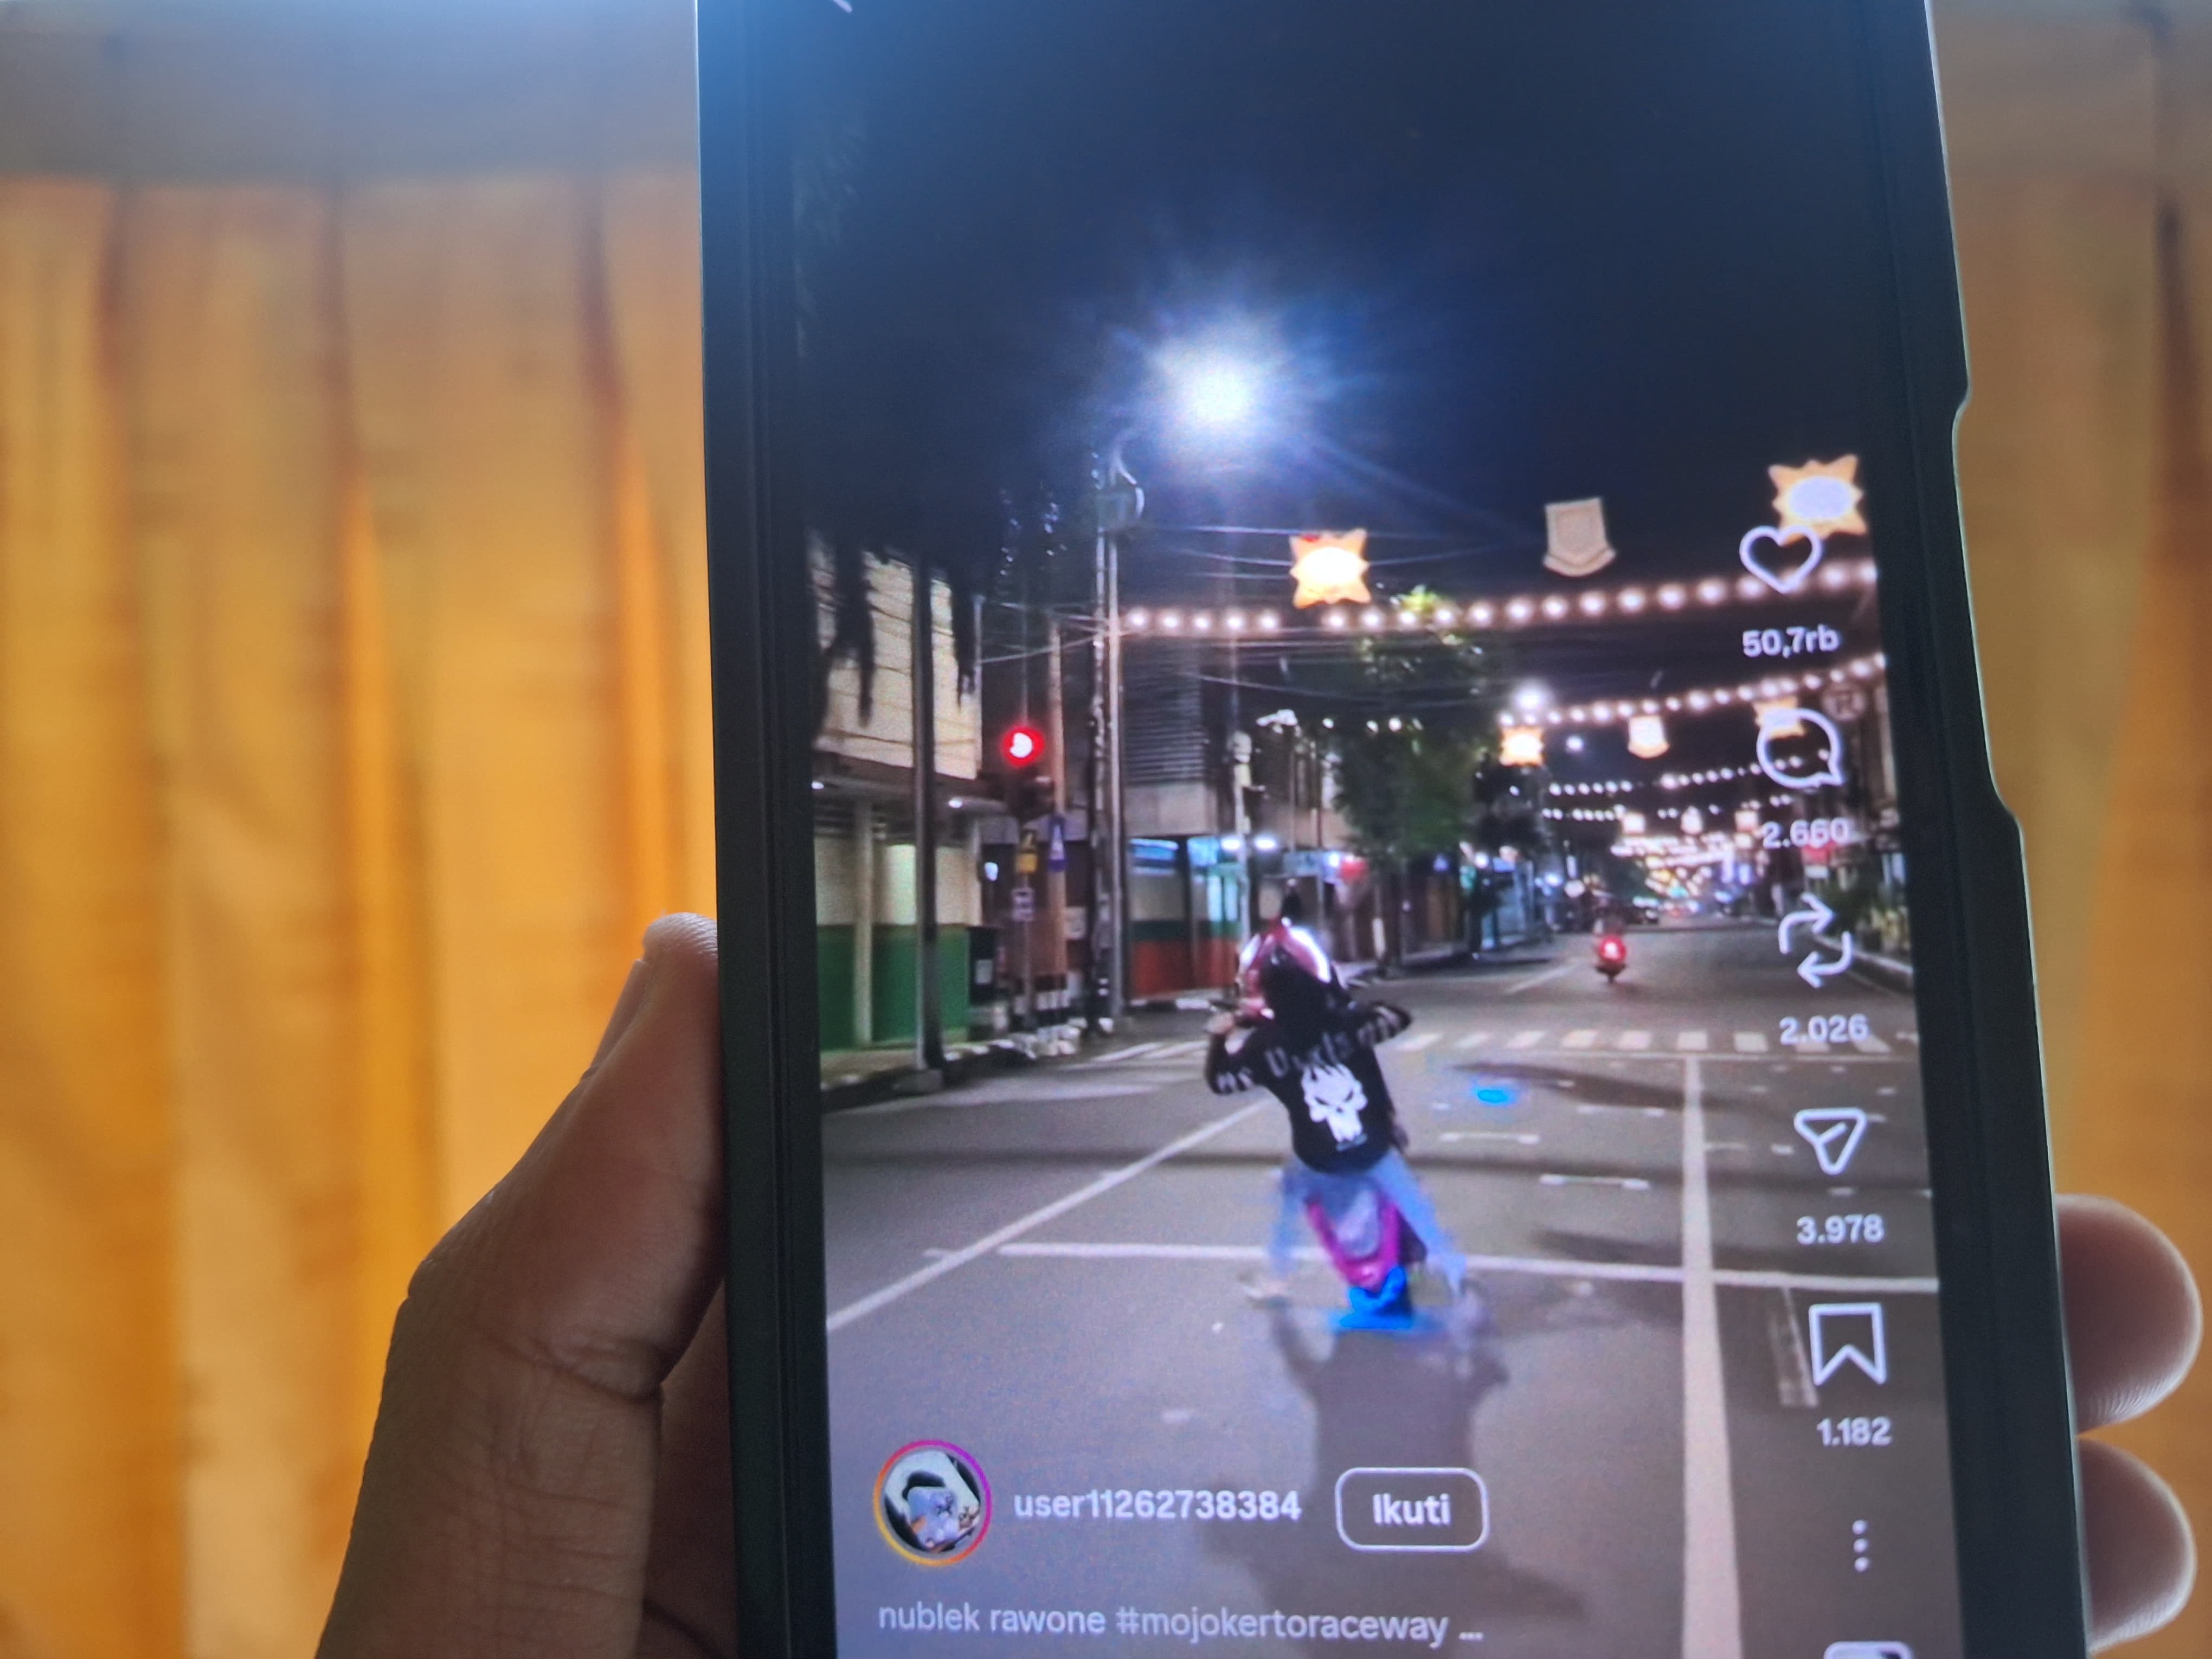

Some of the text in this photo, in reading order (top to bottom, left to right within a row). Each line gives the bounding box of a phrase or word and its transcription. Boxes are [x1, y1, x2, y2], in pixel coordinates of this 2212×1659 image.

[1742, 624, 1839, 659] 50,7rb
[1763, 817, 1848, 849] 2.660
[1779, 1013, 1869, 1045] 2.026
[1796, 1214, 1885, 1245] 3.978
[1816, 1416, 1892, 1446] 1.182
[1013, 1489, 1301, 1522] user11262738384
[1373, 1493, 1451, 1525] Ikuti
[878, 1601, 980, 1631] nublek
[989, 1607, 1106, 1635] rawone
[1115, 1605, 1449, 1649] #mojokertoraceway
